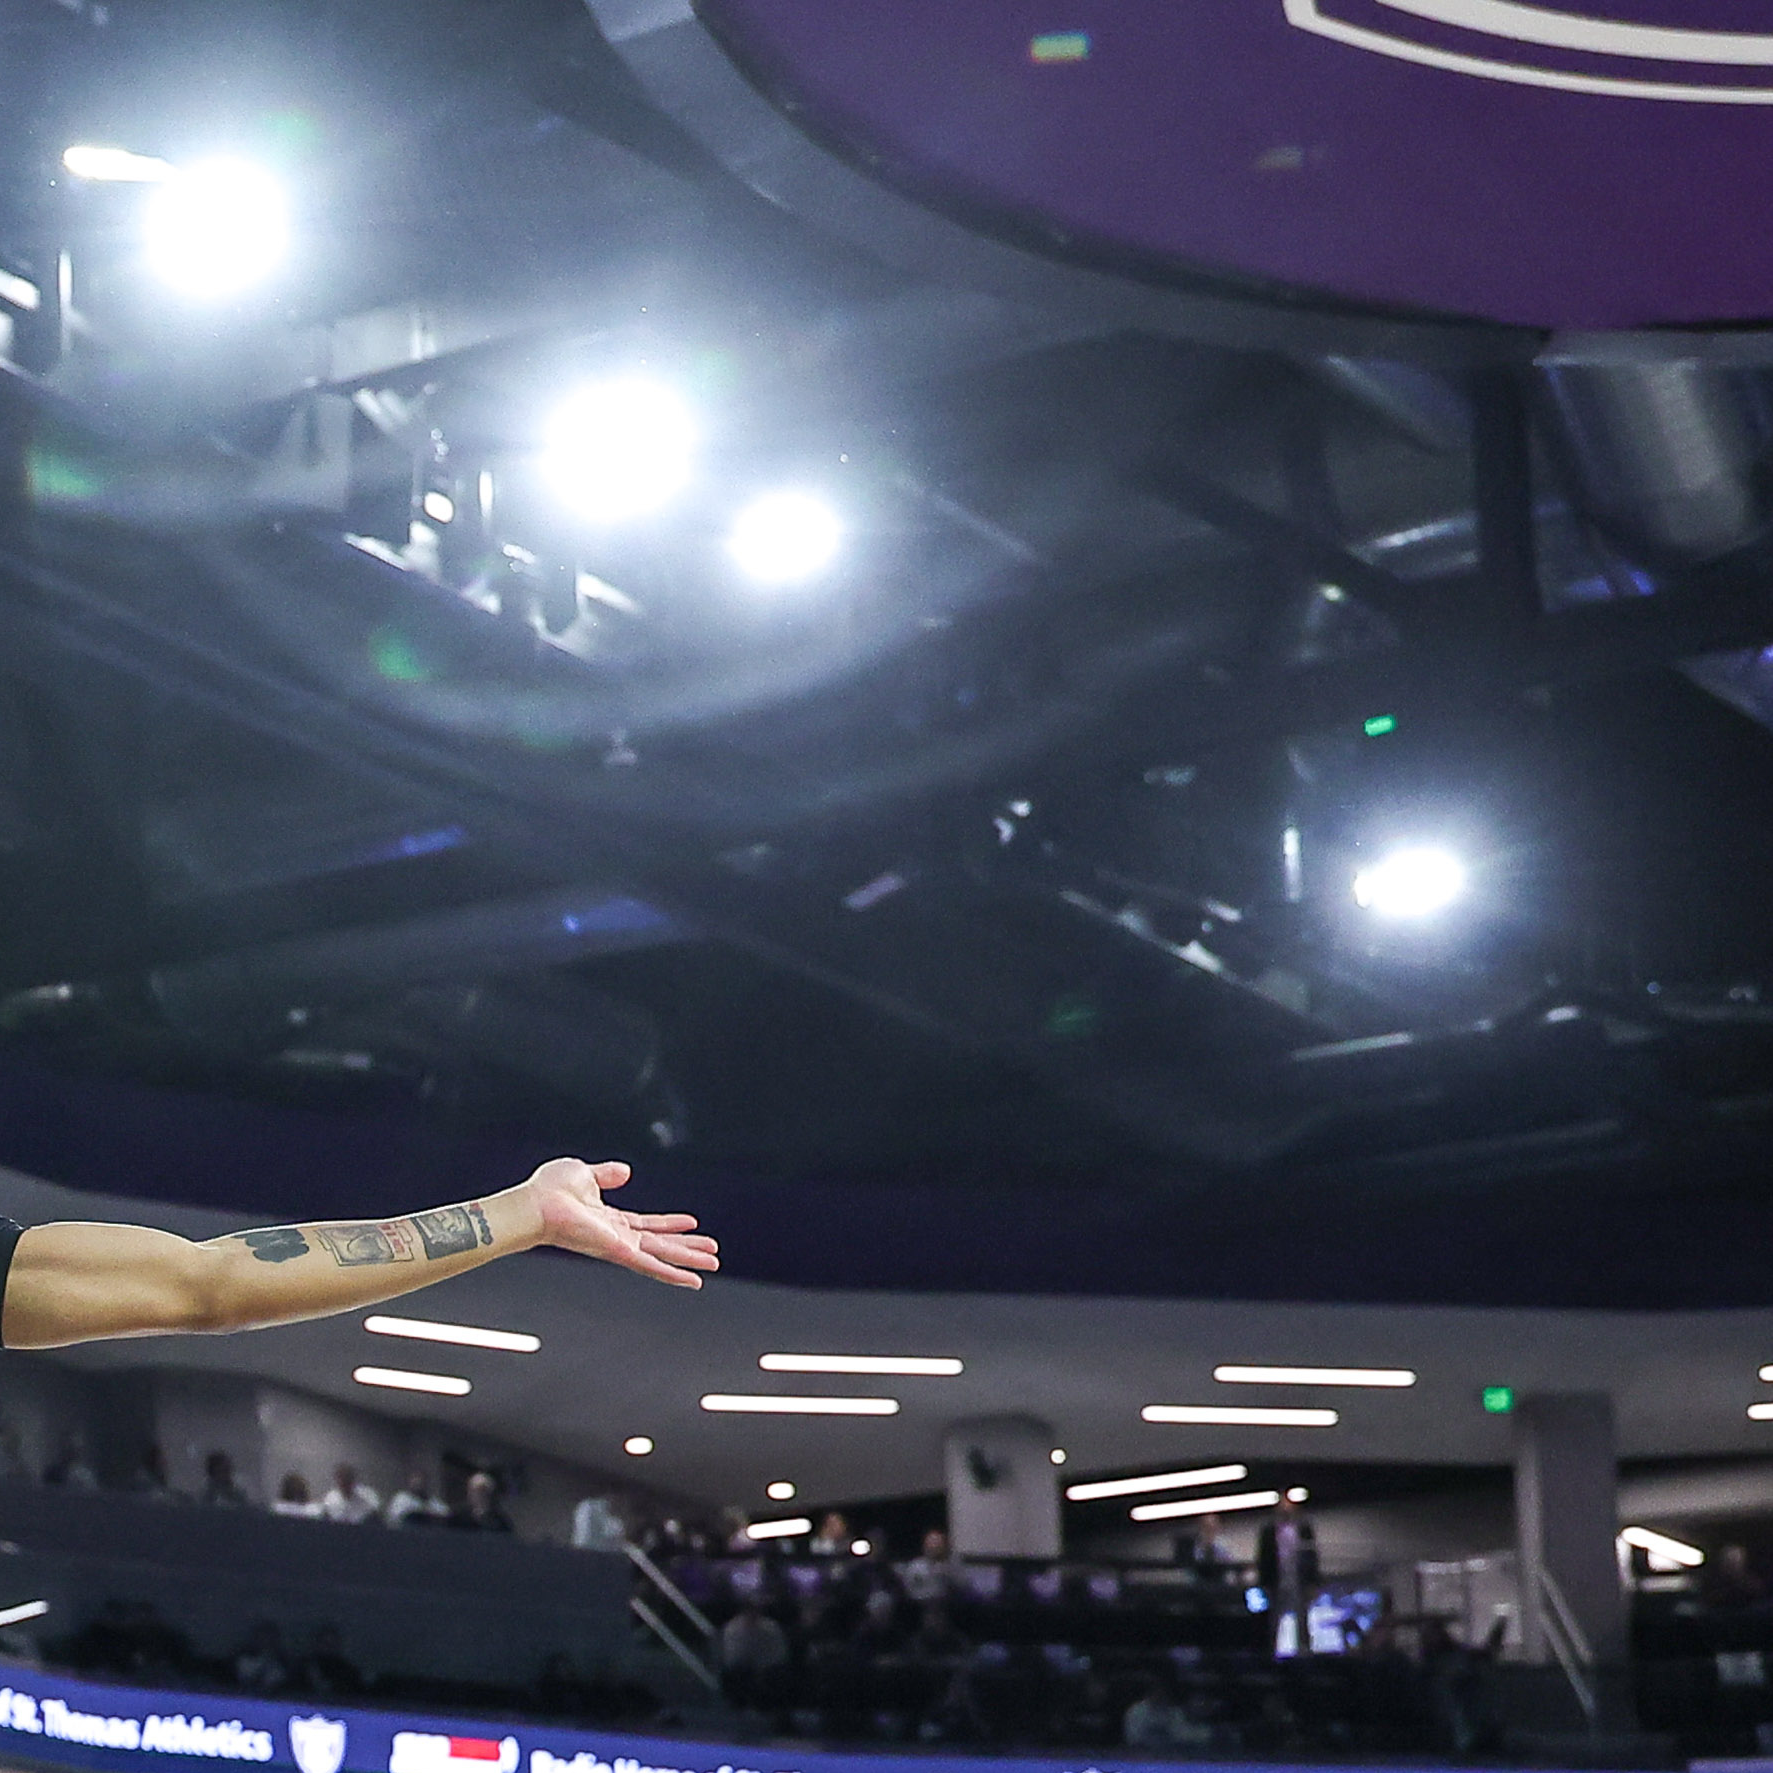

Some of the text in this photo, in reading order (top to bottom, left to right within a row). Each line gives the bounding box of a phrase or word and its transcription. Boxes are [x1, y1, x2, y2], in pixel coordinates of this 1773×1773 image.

[11, 1691, 43, 1734] St.
[40, 1698, 140, 1750] Thomas
[141, 1714, 274, 1763] Athletics
